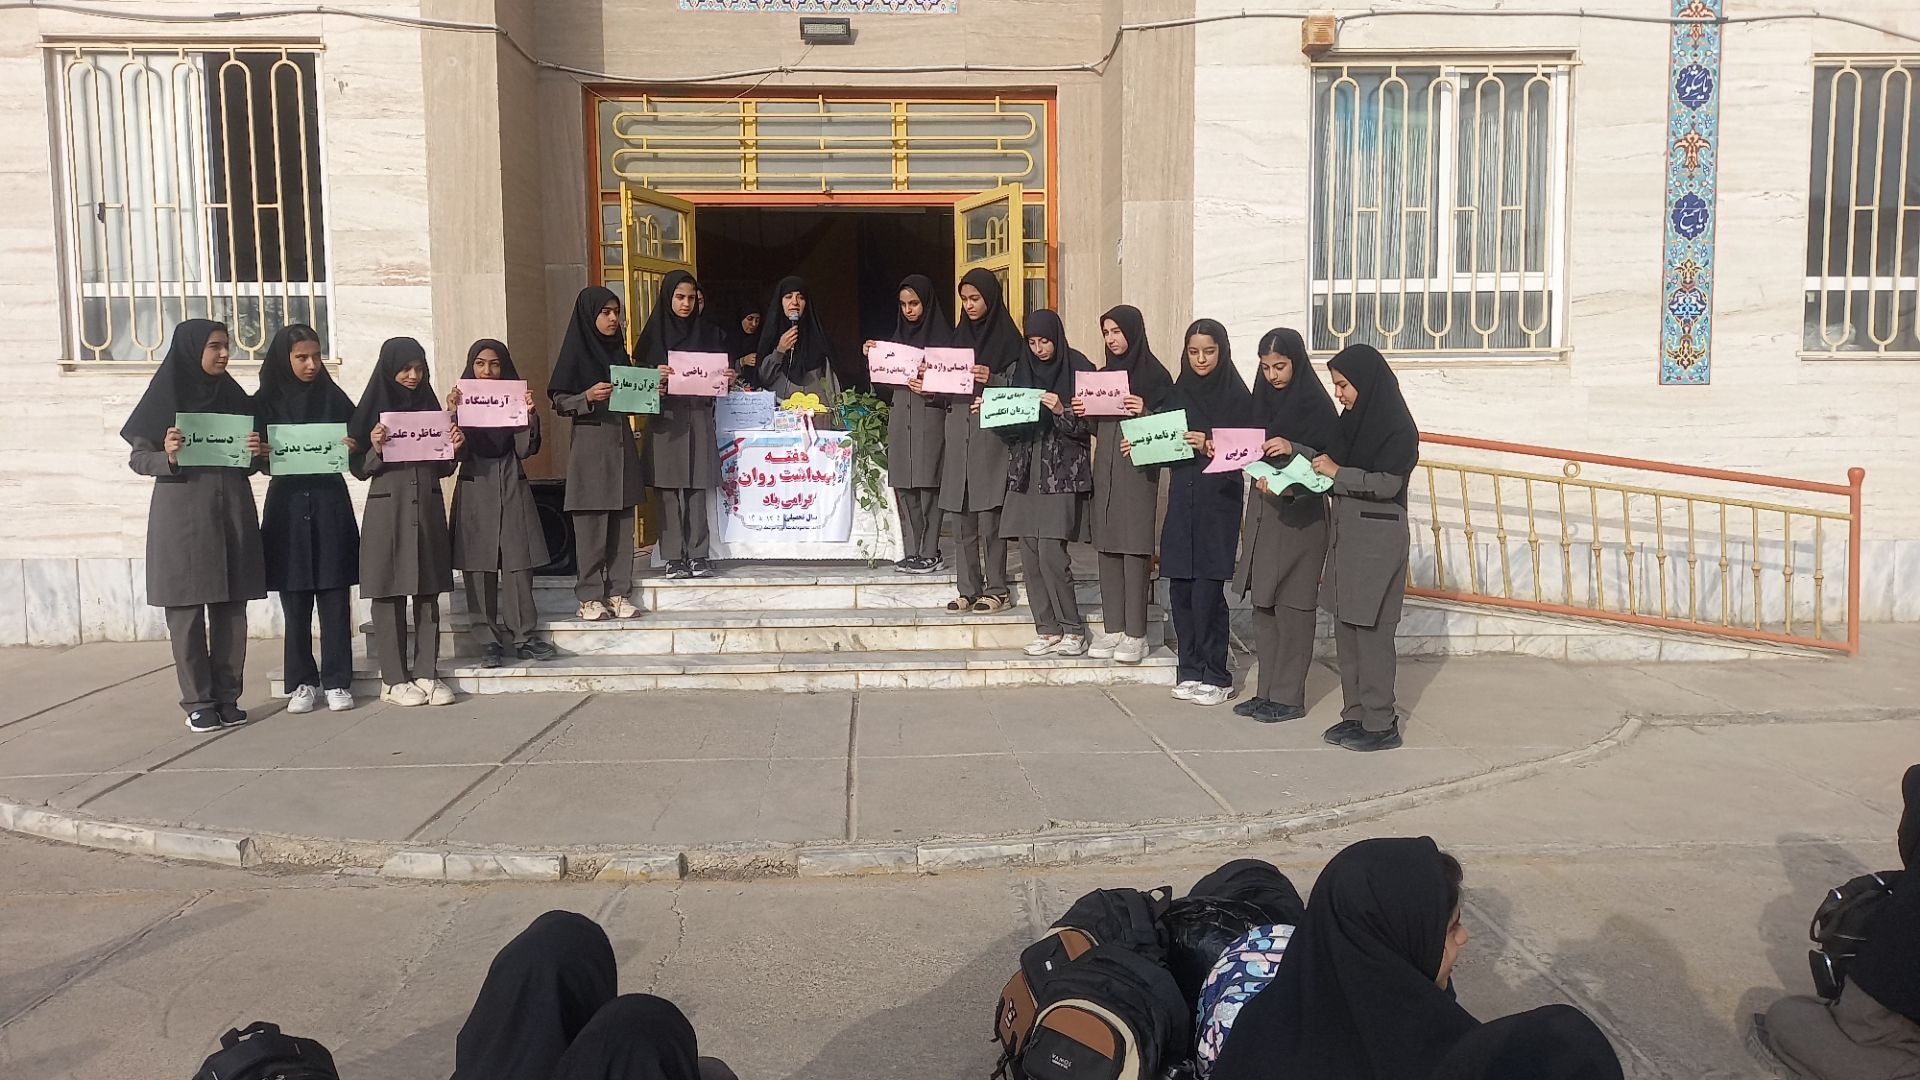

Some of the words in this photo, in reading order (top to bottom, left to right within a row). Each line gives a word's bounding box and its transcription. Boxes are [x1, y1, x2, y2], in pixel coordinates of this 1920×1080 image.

[682, 366, 708, 378] ریاضی
[947, 363, 968, 372] احساس
[632, 383, 638, 391] و
[638, 378, 655, 393] قرآن
[1077, 388, 1094, 397] مهارتی
[1095, 388, 1107, 397] های
[1107, 388, 1121, 397] بازی
[465, 395, 510, 408] آزمایشگاه
[984, 407, 1009, 419] انگلیسی
[1010, 406, 1025, 416] زبان
[206, 434, 234, 444] دست
[385, 429, 408, 442] علمی
[410, 428, 442, 441] مناظره
[1130, 433, 1153, 447] نویسی
[1154, 430, 1176, 441] برنامه
[274, 442, 301, 456] بدنی
[303, 441, 332, 454] تربیت
[765, 449, 810, 464] هفته
[1225, 448, 1249, 461] عربی
[738, 467, 776, 487] روان
[780, 467, 836, 486] بهداشت
[763, 493, 780, 509] باد
[781, 493, 817, 509] گرامی
[784, 513, 805, 522] تحصیلی
[806, 513, 818, 521] سال
